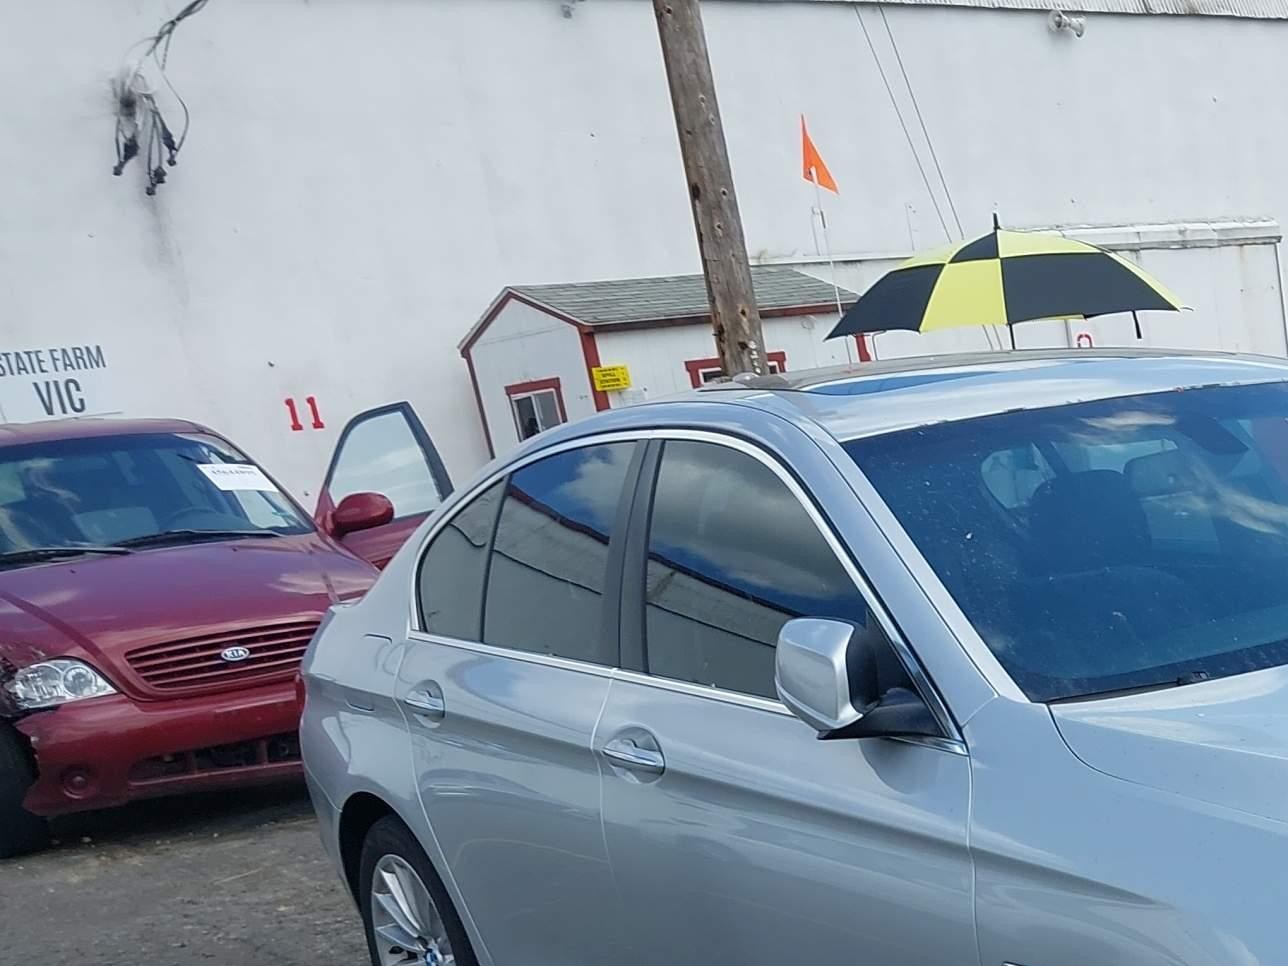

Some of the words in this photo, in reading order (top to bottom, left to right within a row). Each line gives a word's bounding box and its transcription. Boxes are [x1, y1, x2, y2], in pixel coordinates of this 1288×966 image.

[48, 344, 107, 373] FARM
[32, 378, 86, 416] VIC
[285, 396, 325, 431] 11
